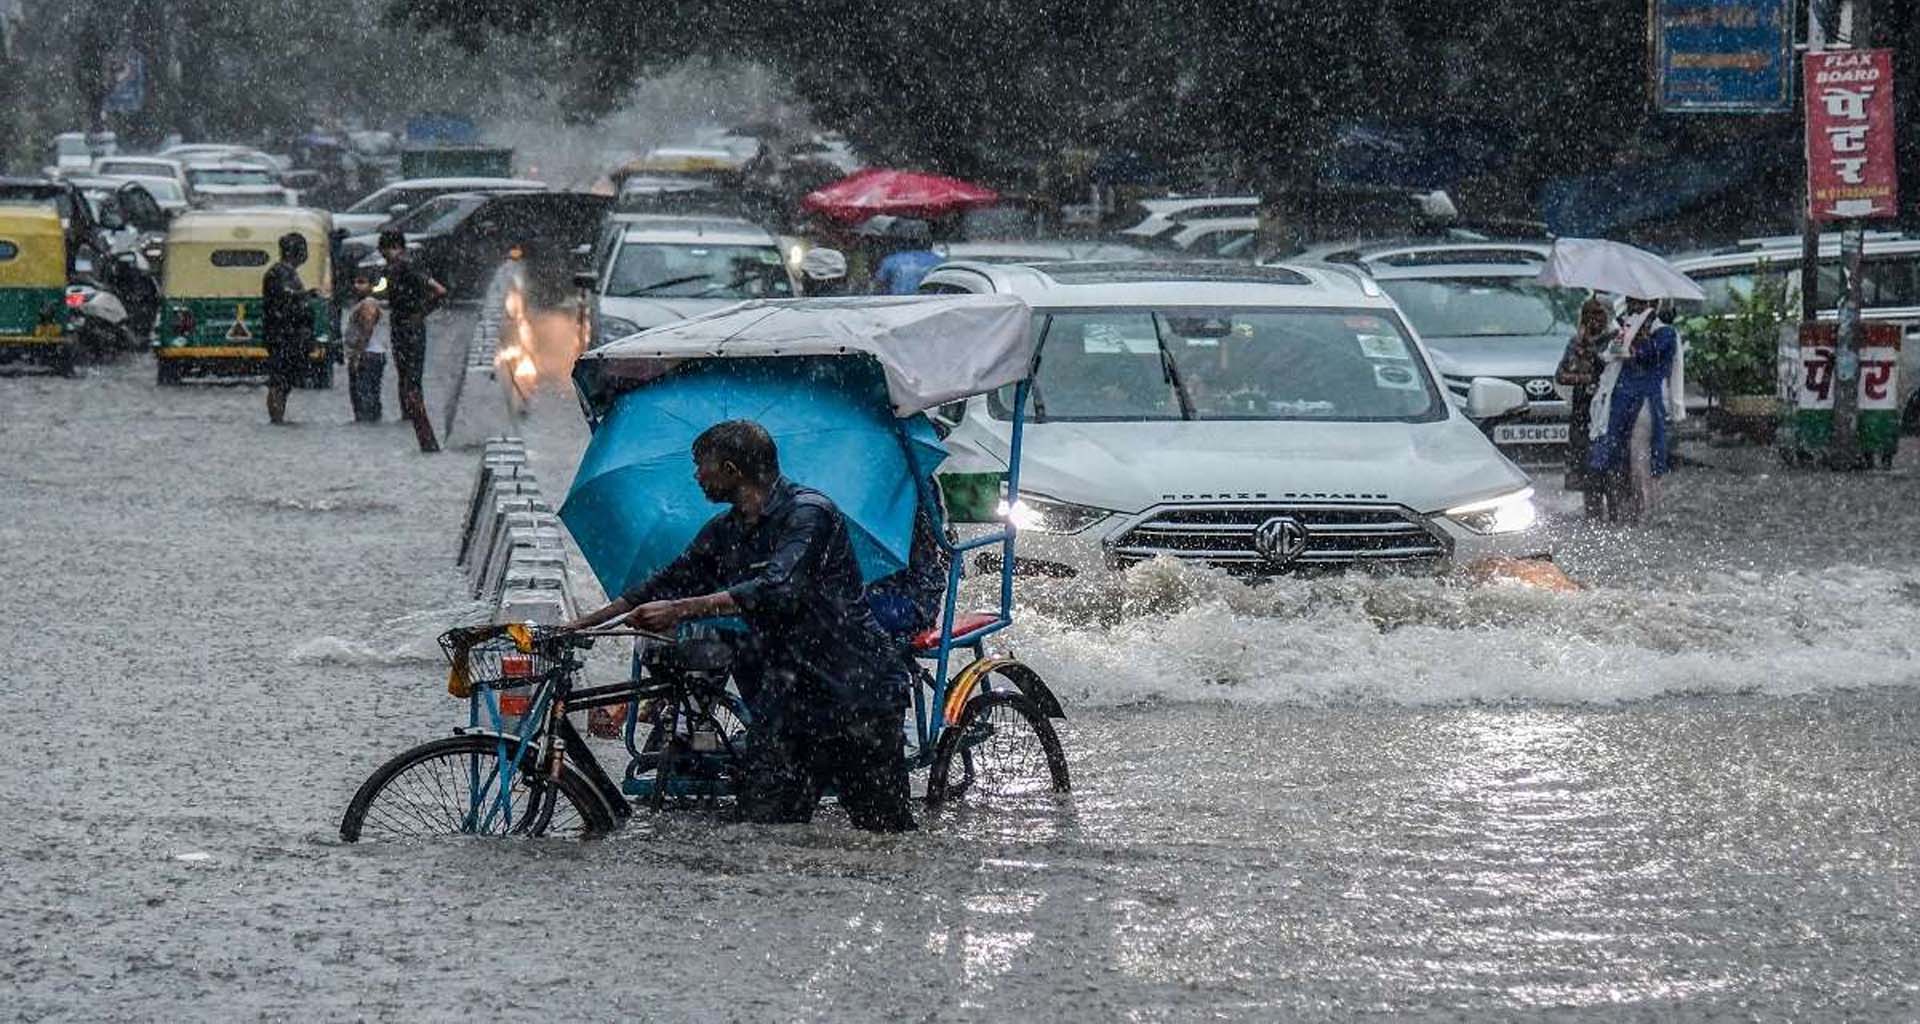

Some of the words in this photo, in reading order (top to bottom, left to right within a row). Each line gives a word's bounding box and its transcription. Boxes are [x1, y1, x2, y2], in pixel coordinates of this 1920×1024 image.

[1824, 54, 1872, 67] FLAX
[1816, 68, 1880, 84] BOARD
[1502, 427, 1567, 441] DL9CBC30
[1262, 521, 1302, 556] MG
